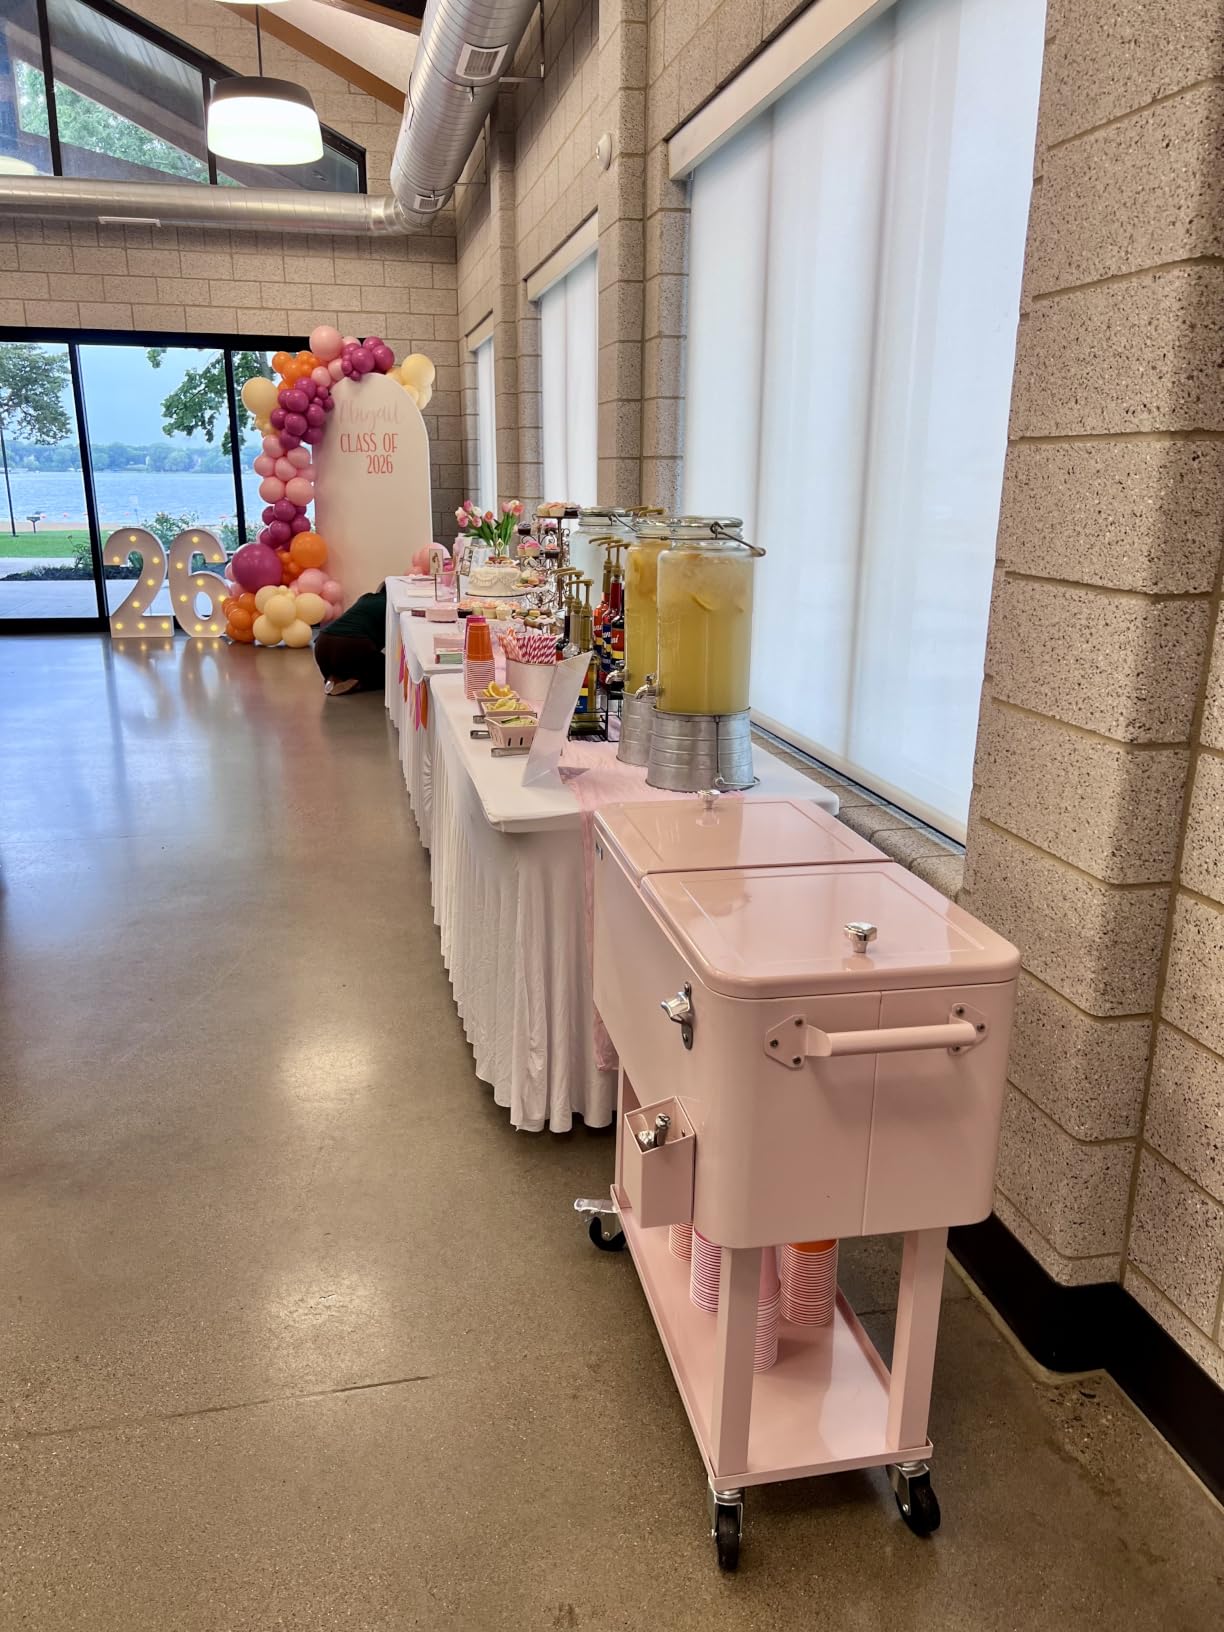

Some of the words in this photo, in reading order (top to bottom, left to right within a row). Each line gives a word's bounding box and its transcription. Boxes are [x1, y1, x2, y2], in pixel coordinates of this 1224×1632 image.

[340, 432, 377, 453] CLASS
[383, 432, 398, 453] OF
[366, 455, 393, 474] 2026
[103, 527, 229, 638] 26
